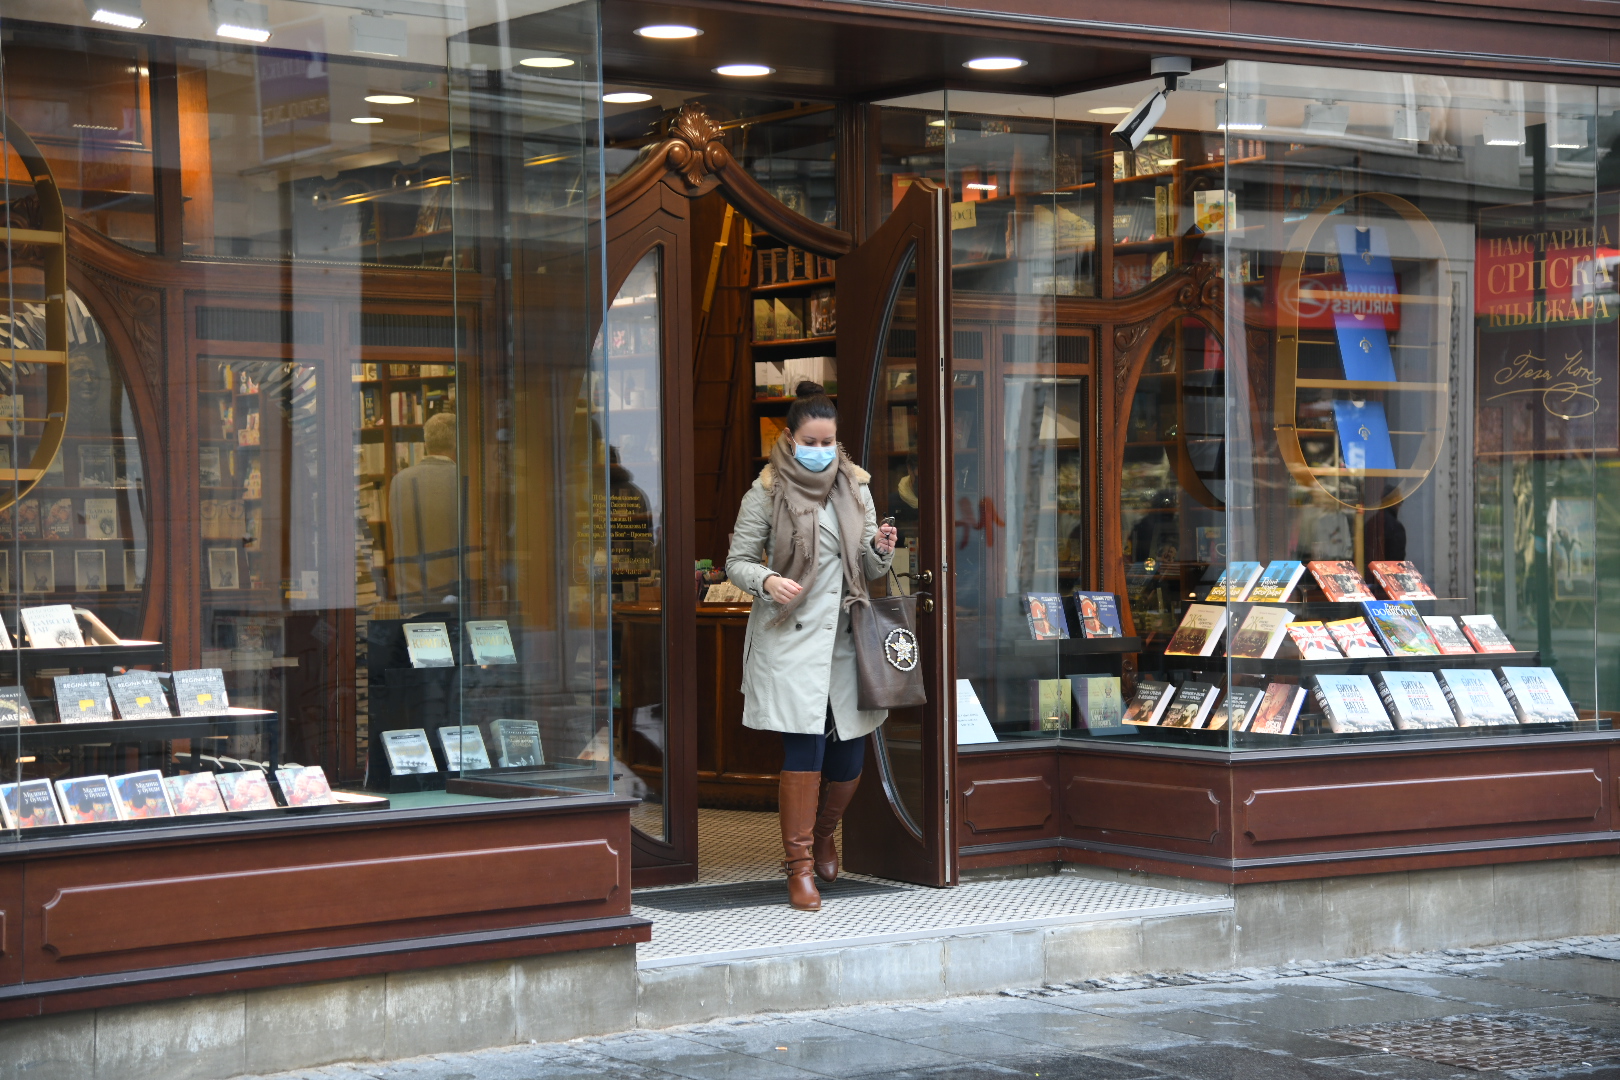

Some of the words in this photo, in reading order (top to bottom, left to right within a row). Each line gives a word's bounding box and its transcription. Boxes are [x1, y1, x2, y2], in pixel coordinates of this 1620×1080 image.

[1489, 225, 1611, 258] НАЈСТАРИЈА
[1488, 254, 1613, 294] СРПСКА
[1489, 295, 1610, 327] КЊИЖАРА
[1469, 695, 1492, 703] BATTLE
[1530, 693, 1553, 701] BATTLE
[1344, 701, 1368, 710] BATTLE
[1409, 698, 1432, 707] BATTLE
